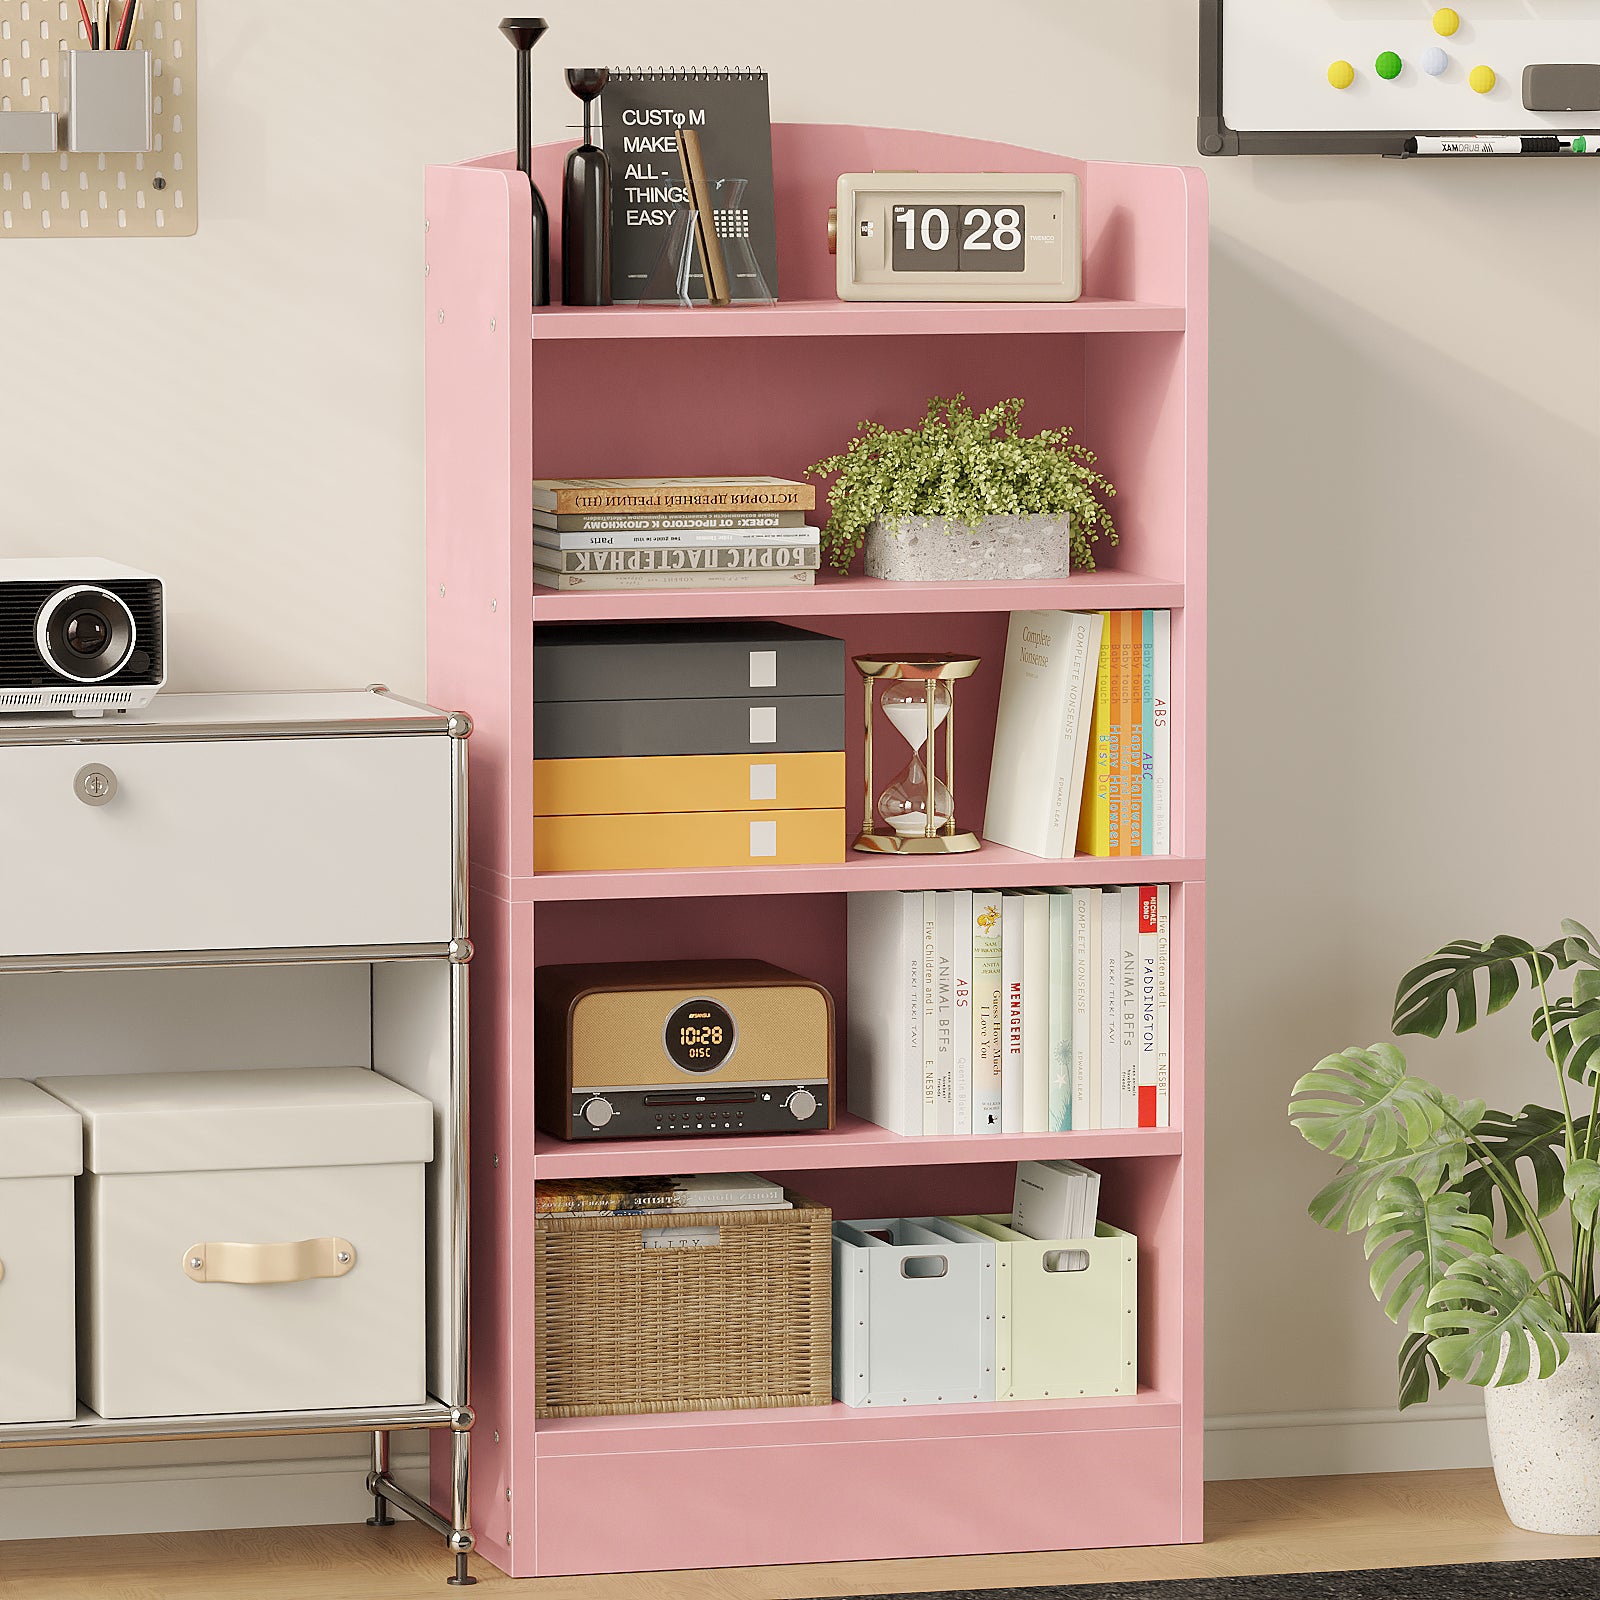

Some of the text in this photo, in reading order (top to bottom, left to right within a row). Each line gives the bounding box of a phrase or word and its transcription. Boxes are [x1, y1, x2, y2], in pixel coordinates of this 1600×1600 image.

[623, 136, 679, 153] MAKE
[624, 163, 659, 180] ALL
[626, 209, 677, 226] EASY
[896, 208, 1022, 251] 10 28
[606, 494, 661, 507] ГРЕЦИИ
[664, 494, 728, 508] ДРЕВНЕЙ
[731, 493, 798, 504] ИСТОРИЯ
[583, 518, 779, 530] FOREX: ОТ ПРОСТОГО К СЛОЖНОМУ
[590, 537, 614, 545] Paris
[576, 549, 719, 571] ПАСТЕРНАК
[726, 548, 805, 568] БОРИС
[1022, 626, 1052, 648] Complete
[1020, 647, 1049, 668] Nonsense
[1064, 625, 1085, 741] COMPLETE NONSENSE
[1100, 644, 1109, 704] Baby touch
[1111, 644, 1120, 704] Baby touch
[1133, 644, 1142, 704] Baby touch
[1143, 644, 1152, 704] Baby touch
[1154, 698, 1166, 727] ABS
[1098, 735, 1110, 800] Busy Day
[1142, 752, 1153, 780] ABC
[1055, 776, 1065, 808] EDWARD
[1109, 725, 1121, 847] Happy Halloween
[1131, 724, 1142, 847] Happy Halloween
[926, 921, 934, 1016] Five Children and It
[1077, 899, 1086, 1014] COMPLETE NONSENSE
[1159, 915, 1167, 1008] Five Children and It
[957, 978, 968, 1007] ABS
[1143, 958, 1154, 1052] PADDINGTON
[981, 1013, 990, 1037] Love
[992, 990, 1001, 1076] Guess How Much
[1010, 982, 1021, 1054] MENAGERIE
[1123, 1013, 1134, 1046] BFFs
[681, 1026, 723, 1046] 10:28
[939, 1019, 949, 1052] BFFs
[981, 1040, 990, 1059] You
[926, 1060, 934, 1105] E. NESBIT
[1158, 1052, 1167, 1097] E. NESBIT
